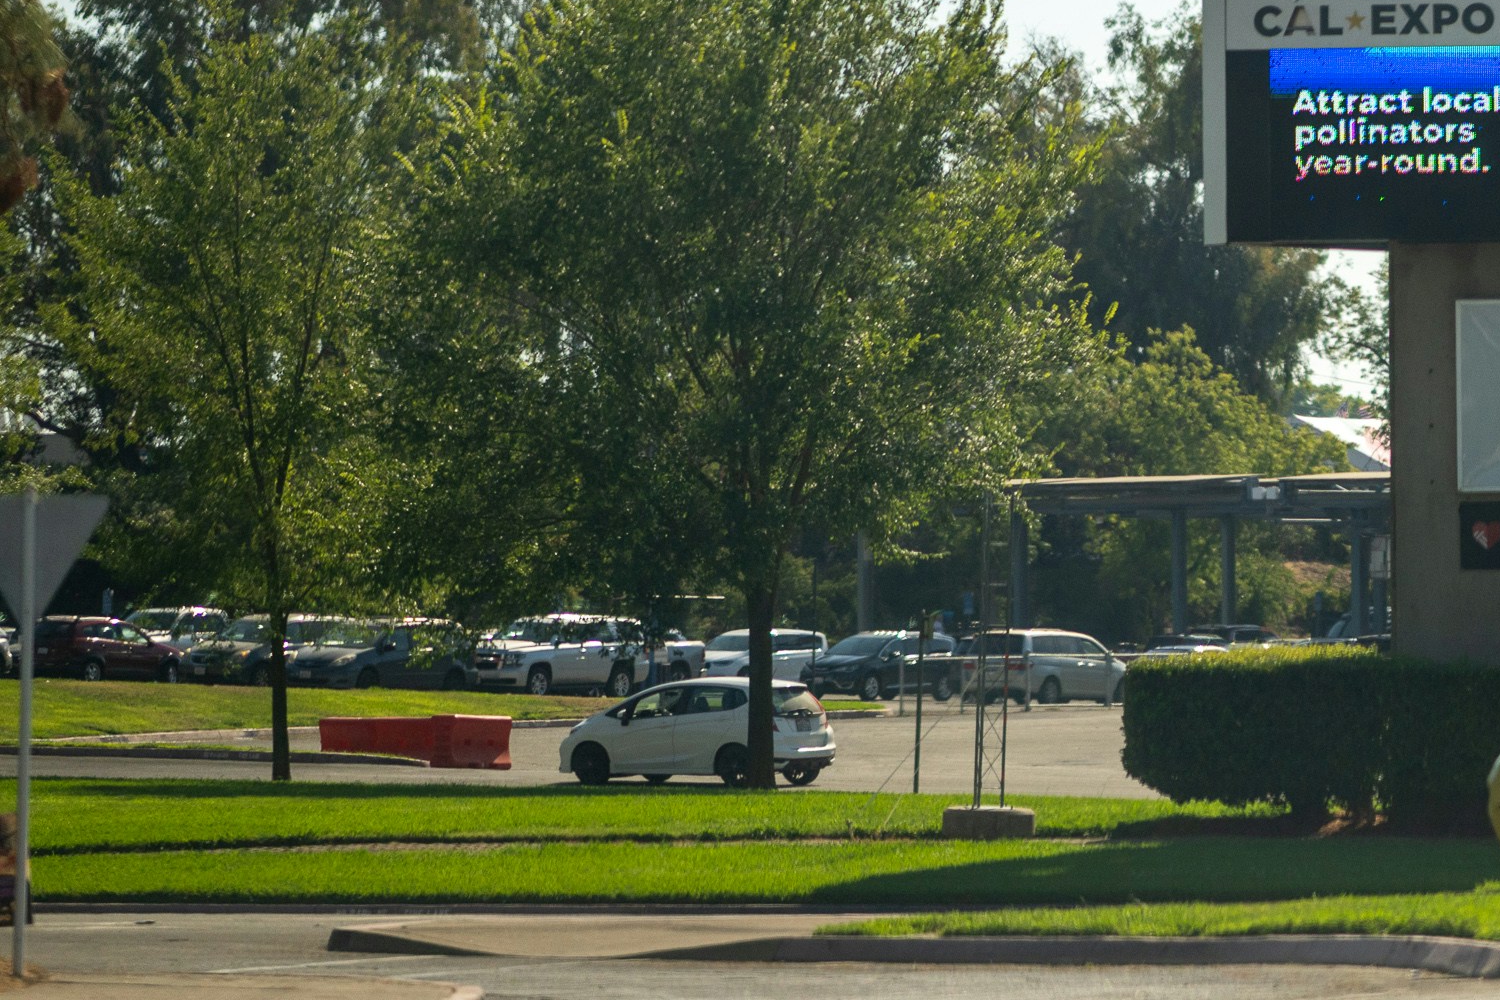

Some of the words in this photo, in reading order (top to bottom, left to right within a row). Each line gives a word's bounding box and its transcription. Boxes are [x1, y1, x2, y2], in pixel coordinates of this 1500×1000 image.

[1253, 4, 1344, 37] CAL
[1371, 2, 1495, 36] EXPO
[1292, 88, 1415, 115] Attract
[1294, 116, 1477, 151] pollinators
[1294, 147, 1492, 182] year-round.
